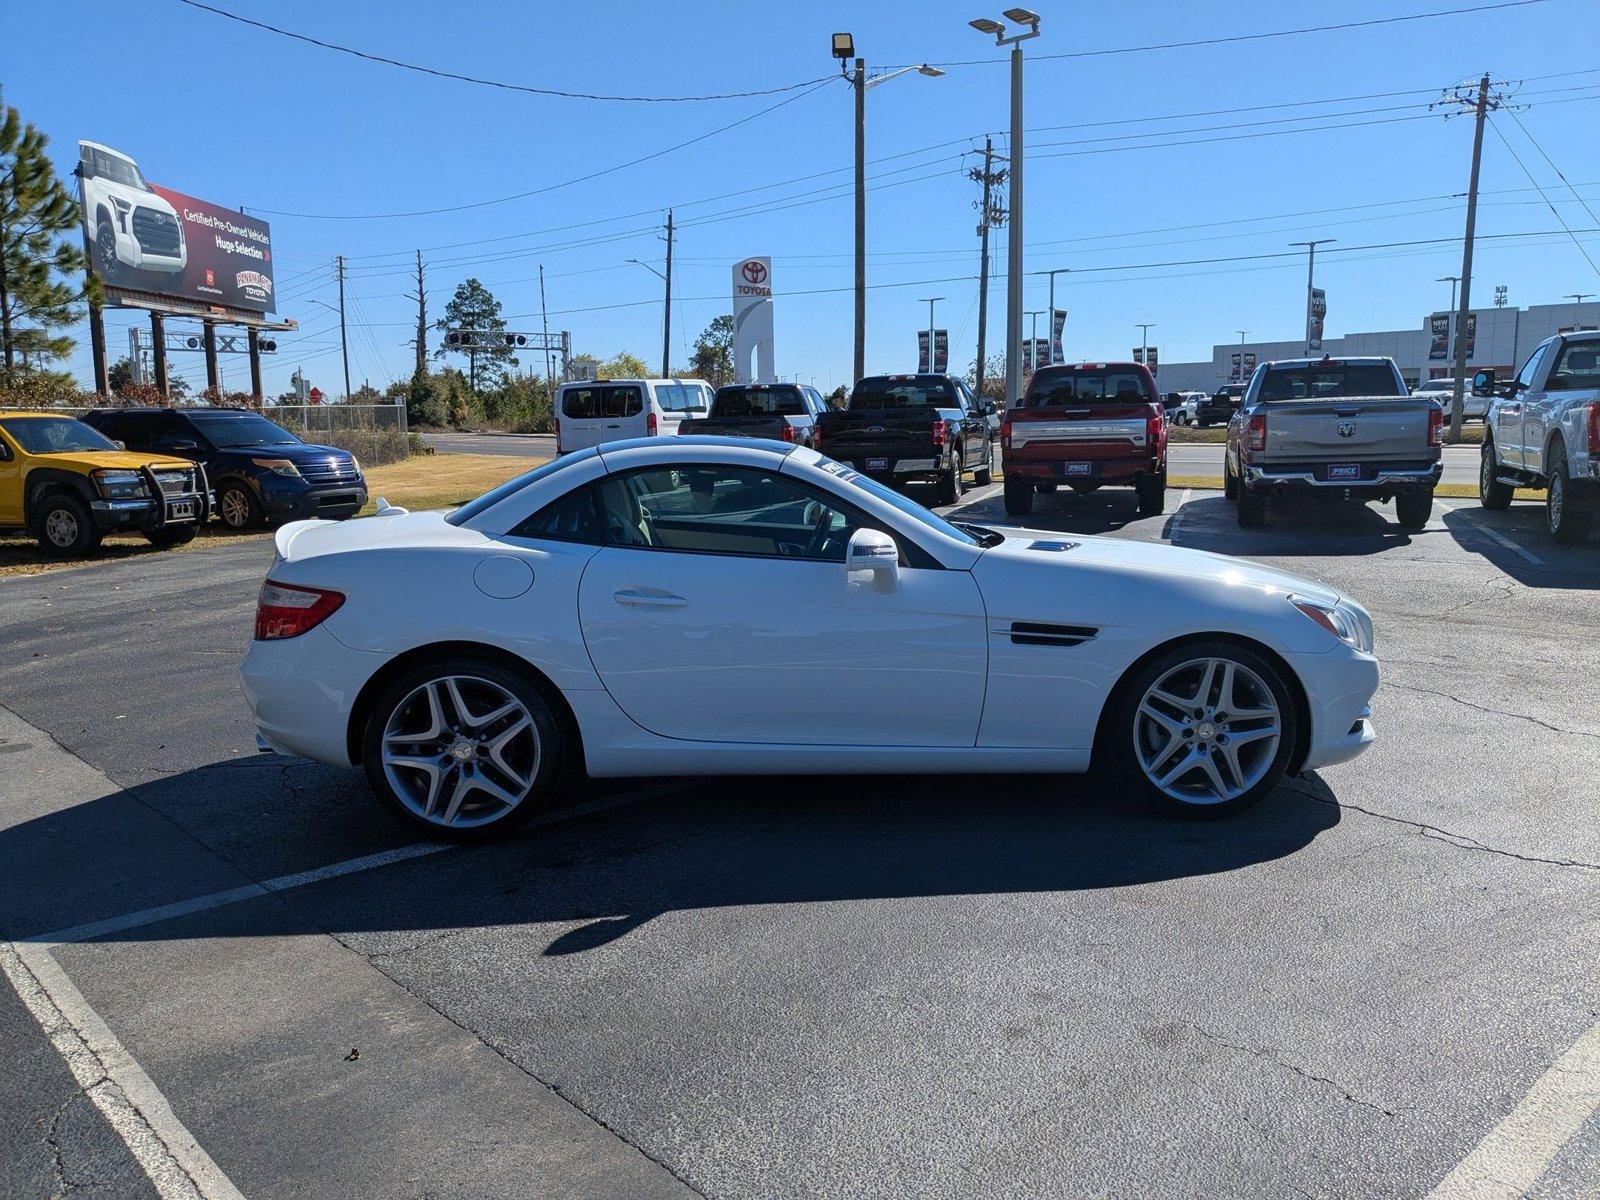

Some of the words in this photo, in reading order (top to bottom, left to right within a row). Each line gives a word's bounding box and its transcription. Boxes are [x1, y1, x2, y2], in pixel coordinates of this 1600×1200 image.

[184, 208, 213, 227] Certified
[214, 217, 248, 238] Pre-Owned
[248, 228, 270, 244] Vehicles
[215, 234, 234, 254] Huge
[234, 240, 263, 260] Selection
[246, 286, 266, 297] TOYOTA
[737, 286, 772, 296] TOYOTA
